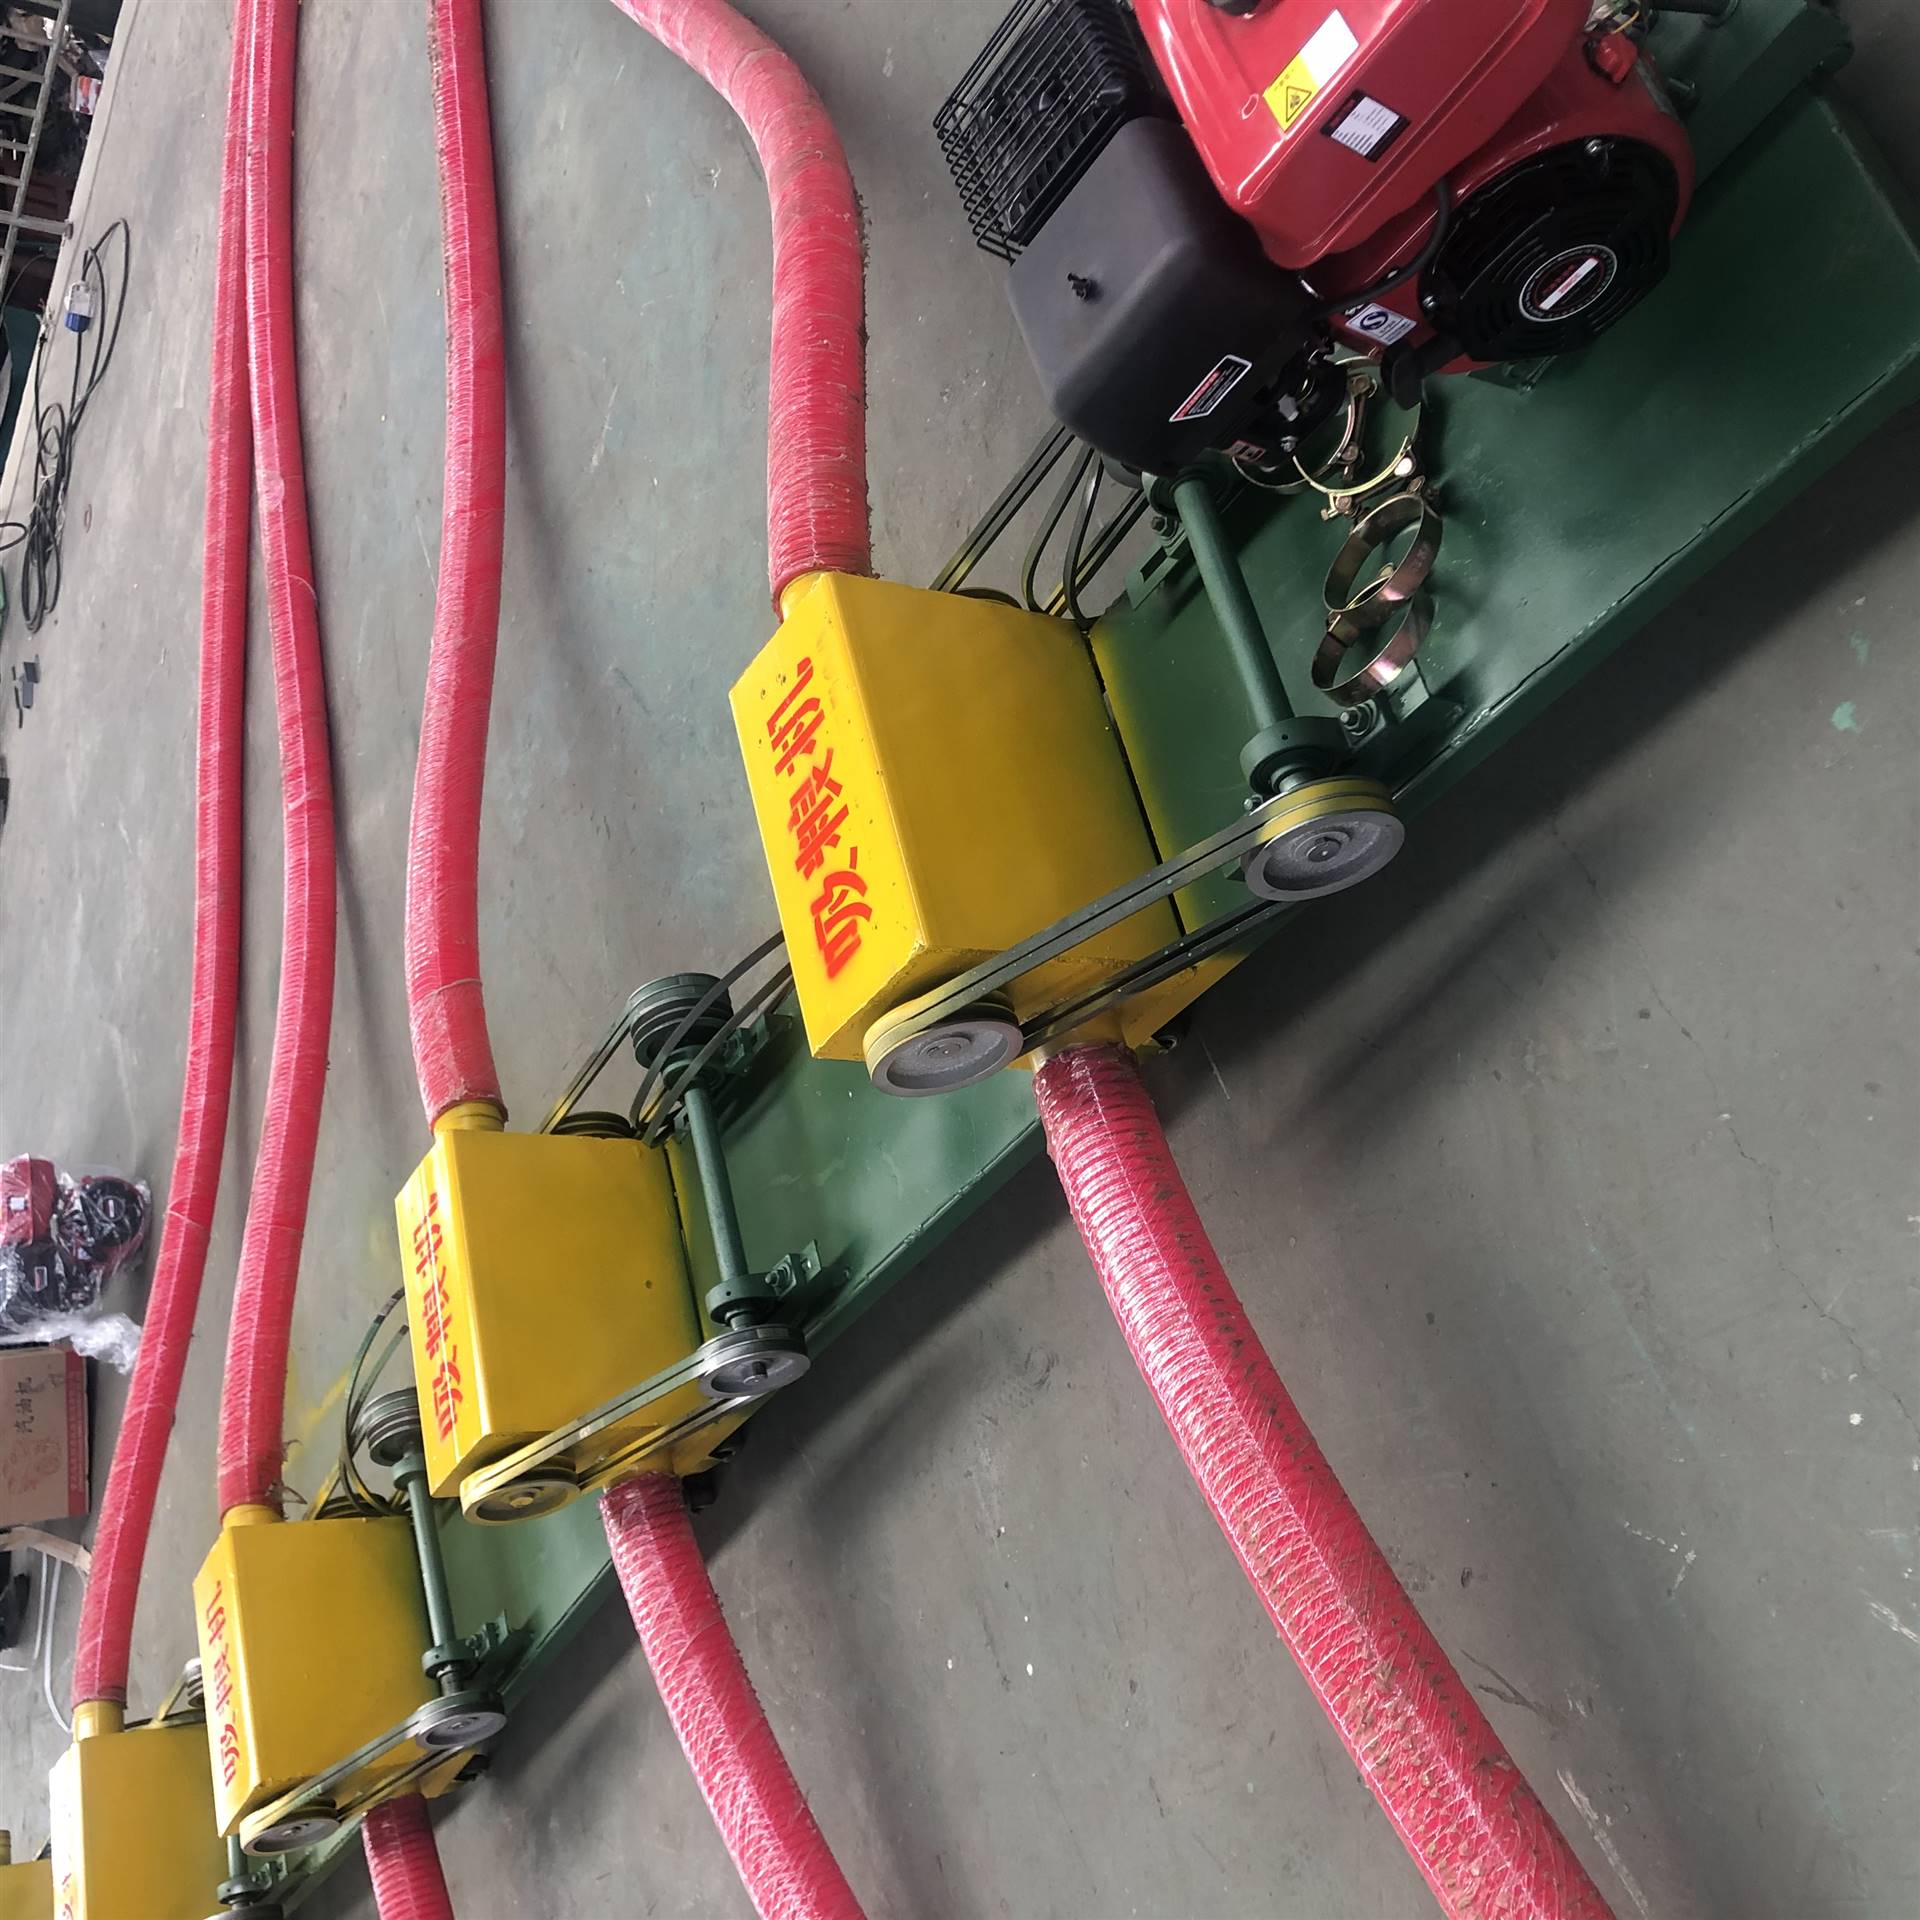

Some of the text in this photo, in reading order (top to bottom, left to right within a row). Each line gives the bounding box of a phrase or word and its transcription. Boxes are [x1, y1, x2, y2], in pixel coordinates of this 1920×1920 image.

[767, 656, 872, 979] 吸粮机
[14, 1377, 34, 1433] 汽油机
[413, 1191, 463, 1441] 吸粮机
